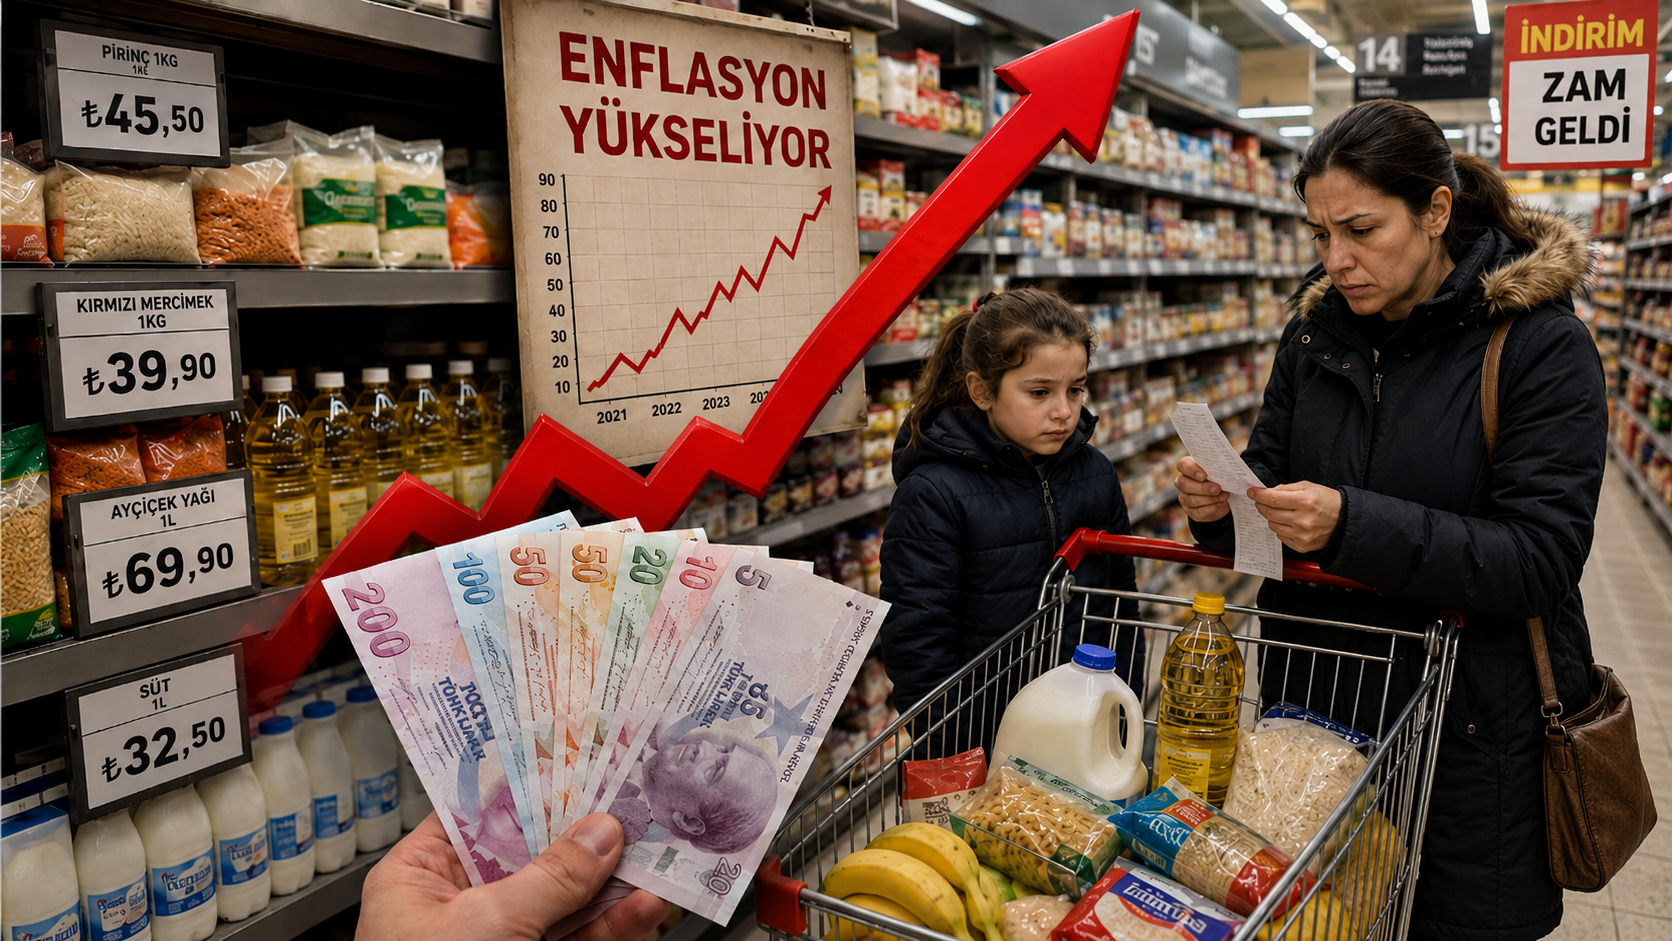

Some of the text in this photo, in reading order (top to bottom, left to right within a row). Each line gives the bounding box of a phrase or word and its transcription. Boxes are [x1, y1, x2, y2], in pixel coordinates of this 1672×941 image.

[1520, 13, 1645, 54] İNDİRİM
[102, 43, 179, 68] PİRİNÇ 1KG
[558, 31, 827, 111] ENFLASYON
[1357, 35, 1402, 73] 14
[1542, 68, 1627, 103] ZAM
[81, 93, 205, 138] ₺45,50
[558, 96, 832, 169] YÜKSELİYOR
[1534, 106, 1631, 146] GELDİ
[1463, 123, 1500, 158] 15
[538, 173, 556, 186] 90
[540, 199, 558, 213] 80
[543, 225, 560, 239] 70
[544, 252, 562, 266] 60
[547, 278, 564, 292] 50
[76, 292, 215, 313] KIRMIZI MERCİMEK
[548, 304, 566, 318] 40
[137, 314, 167, 329] 1KG
[550, 330, 567, 343] 30
[82, 349, 216, 396] ₺39,90
[552, 355, 569, 369] 20
[554, 380, 571, 394] 10
[596, 409, 628, 425] 2021
[651, 402, 682, 417] 2022
[702, 395, 731, 411] 2023
[110, 487, 216, 520] AYÇİÇEK YAĞI
[159, 514, 177, 528] 1L
[102, 542, 234, 599] ₺69,90
[452, 552, 496, 605] 100
[509, 546, 550, 587] 50
[571, 543, 609, 584] 50
[629, 545, 668, 587] 20
[678, 554, 719, 591] 10
[735, 564, 773, 591] 5
[341, 582, 411, 659] 200
[139, 677, 172, 699] SÜT
[151, 697, 168, 711] 1L
[101, 716, 226, 783] ₺32,50
[707, 856, 742, 896] 20
